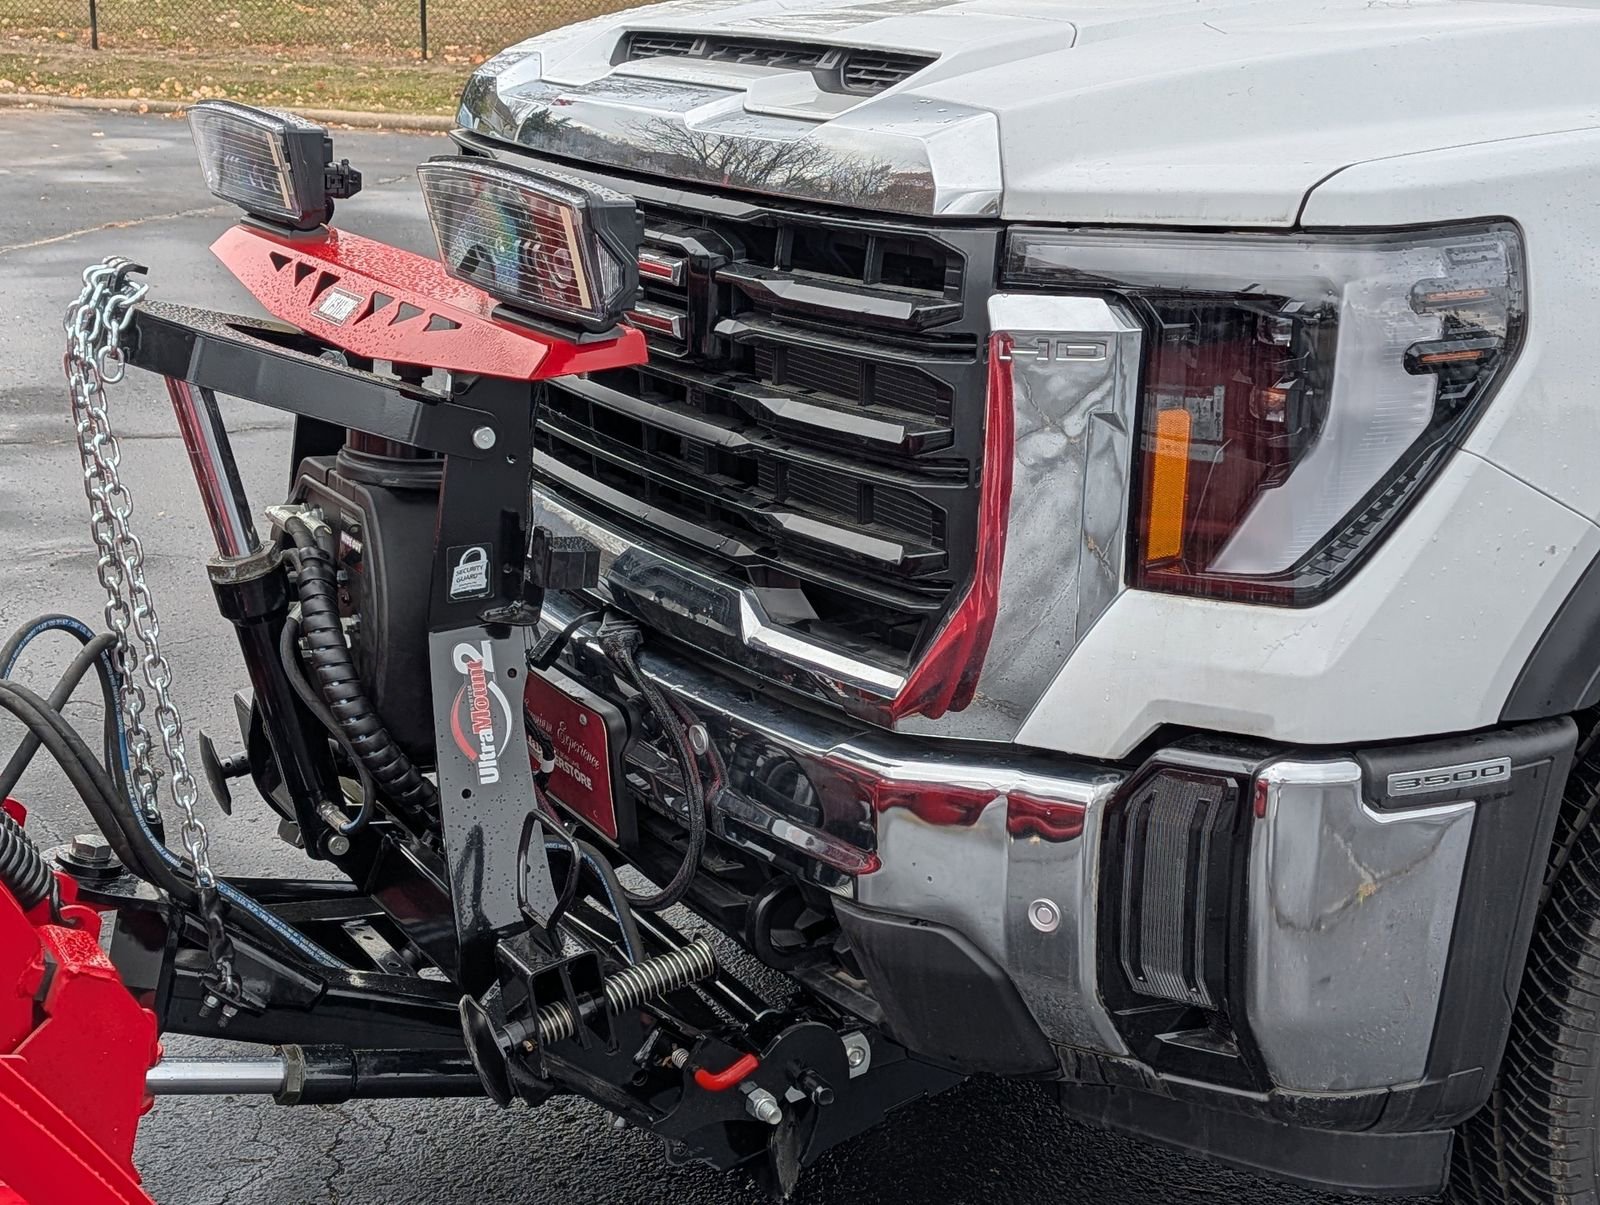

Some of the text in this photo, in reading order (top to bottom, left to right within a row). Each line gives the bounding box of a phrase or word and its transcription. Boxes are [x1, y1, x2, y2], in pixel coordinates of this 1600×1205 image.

[999, 339, 1106, 361] HD
[456, 565, 483, 576] SECURITY
[1395, 764, 1504, 790] 3500
